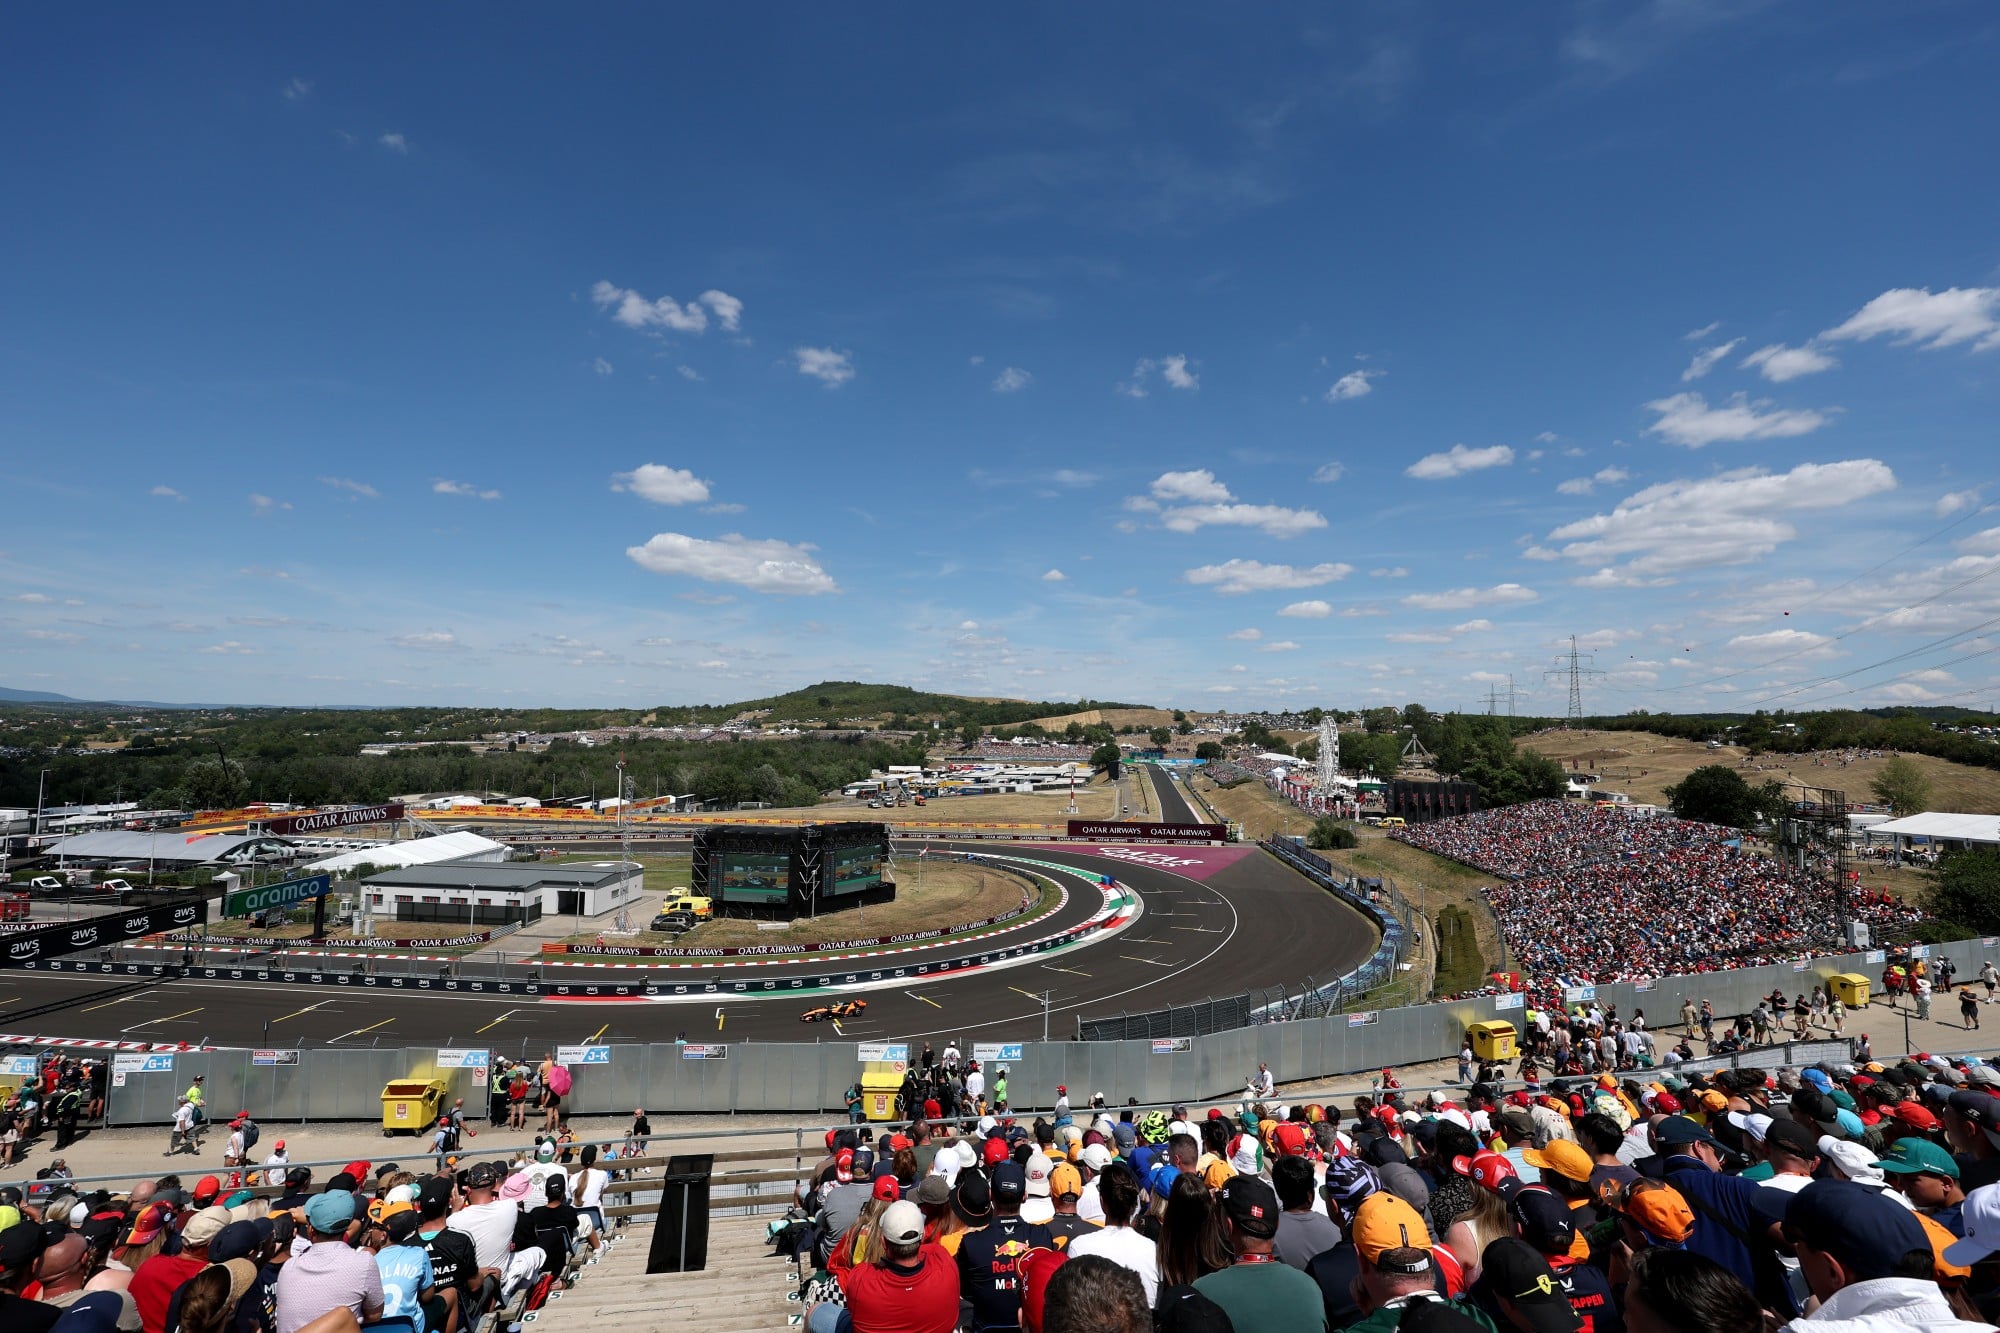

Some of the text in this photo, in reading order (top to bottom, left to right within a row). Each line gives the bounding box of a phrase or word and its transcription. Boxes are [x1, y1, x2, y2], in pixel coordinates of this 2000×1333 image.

[295, 807, 387, 831] QATAR AIRWAYS
[1082, 826, 1142, 835] QATAR AIRWAYS
[1150, 828, 1212, 837] QATAR AIRWAYS
[246, 880, 319, 908] aramco
[174, 906, 195, 918] aws
[126, 916, 149, 928] aws
[949, 920, 989, 934] QATAR AIRWAYS
[71, 927, 97, 940] aws
[890, 930, 942, 943] QATAR AIRWAYS
[246, 937, 274, 946] QATAR
[358, 939, 396, 947] AIRWAYS
[410, 935, 484, 947] QATAR AIRWAYS
[818, 938, 880, 951] QATAR AIRWAYS
[10, 940, 39, 953] aws
[574, 945, 640, 956] QATAR AIRWAYS
[738, 944, 806, 955] QATAR AIRWAYS
[654, 948, 724, 956] QATAR AIRWAYS
[1583, 990, 1595, 998] A-B
[588, 1051, 608, 1061] J-K
[886, 1050, 906, 1060] L-M
[1002, 1048, 1021, 1058] L-M
[148, 1058, 172, 1069] G-H
[466, 1055, 487, 1065] J-K
[14, 1062, 35, 1072] G-H
[433, 1264, 458, 1275] NAS
[992, 1258, 1014, 1273] Red
[788, 1272, 798, 1280] 5
[788, 1292, 799, 1300] 6
[524, 1312, 536, 1322] 6
[791, 1315, 801, 1325] 7
